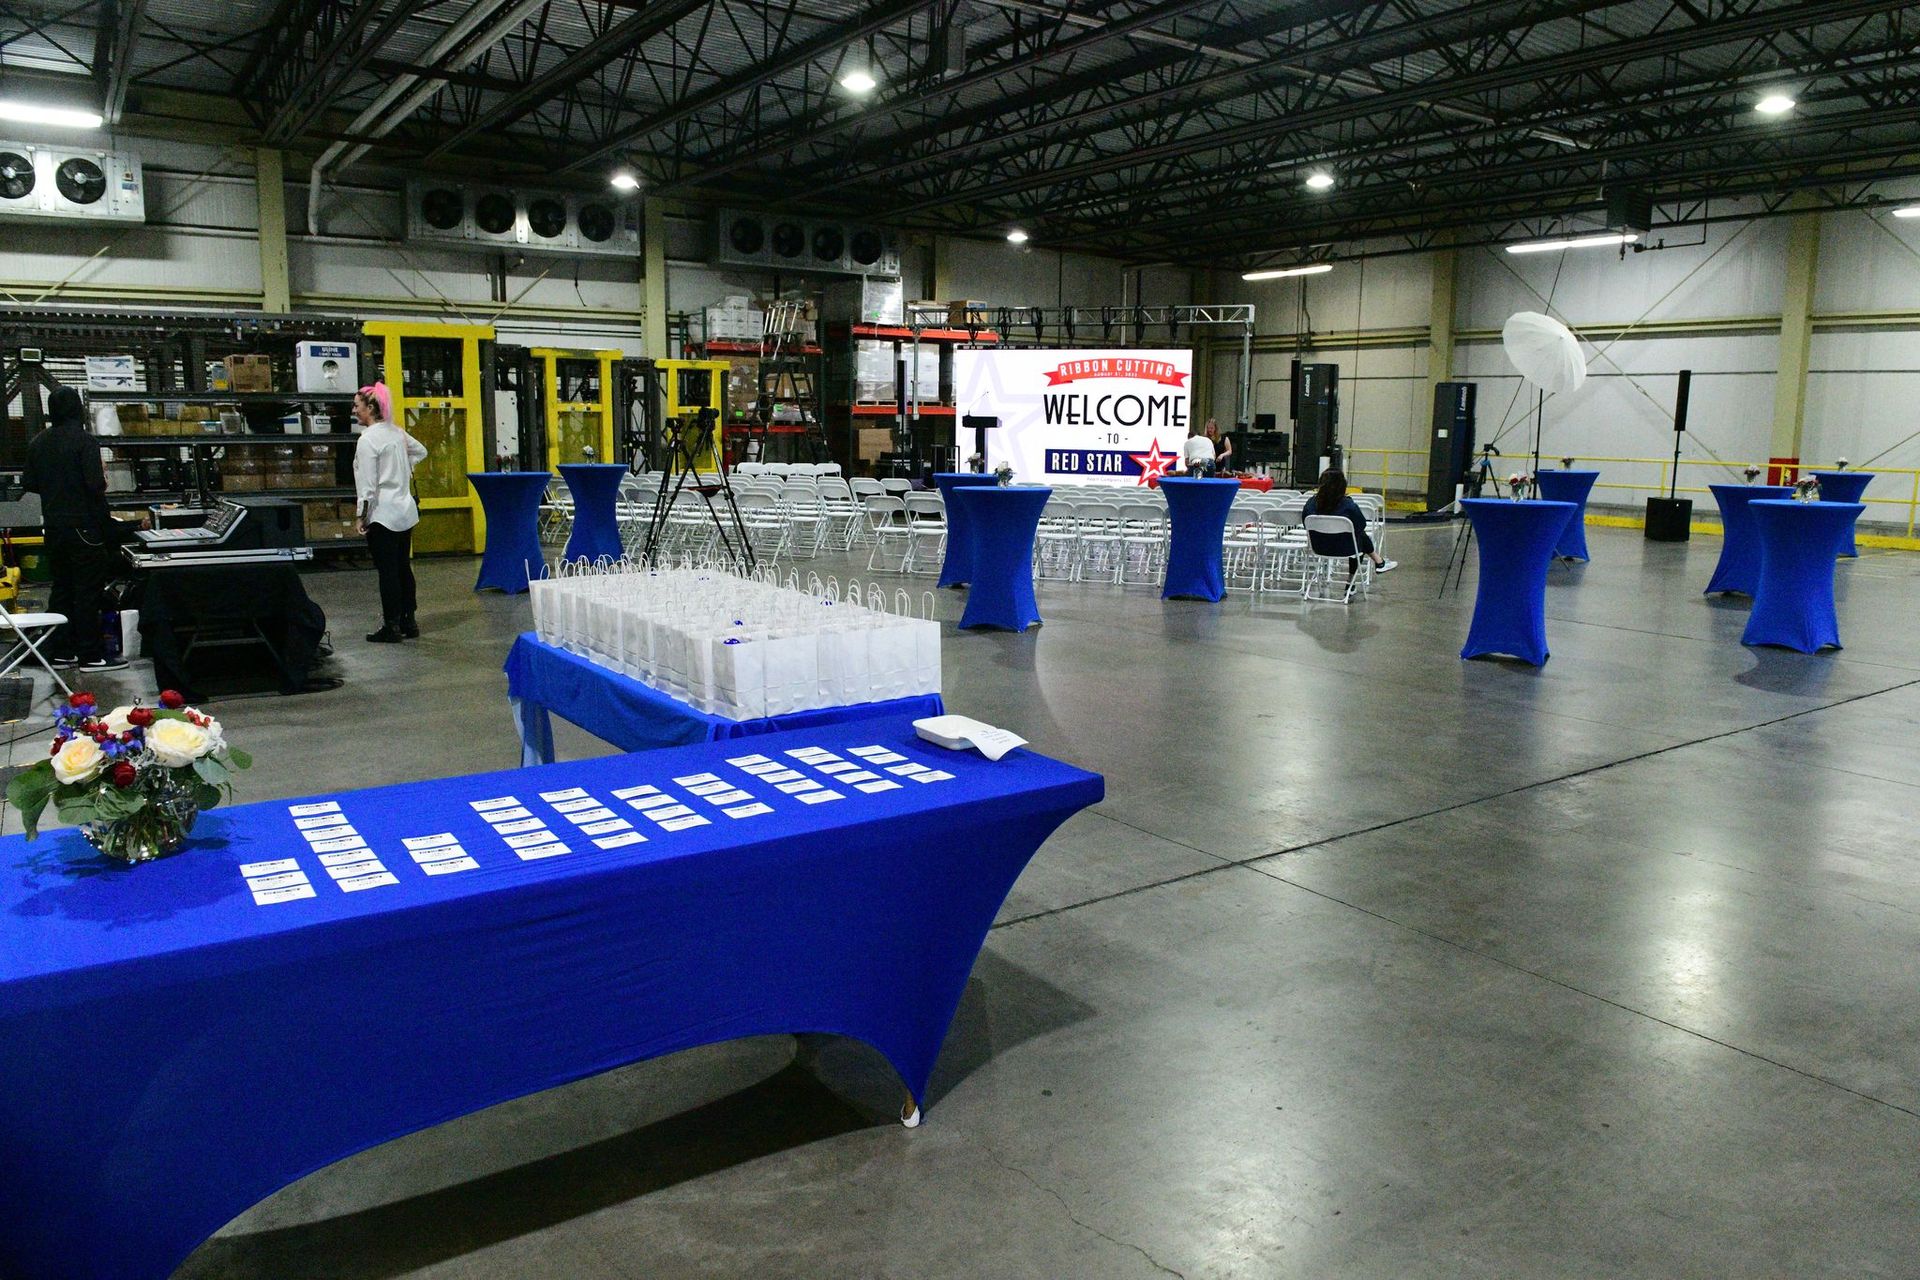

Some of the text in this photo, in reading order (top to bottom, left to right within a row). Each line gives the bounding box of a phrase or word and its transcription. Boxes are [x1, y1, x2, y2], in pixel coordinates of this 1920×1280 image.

[1060, 359, 1175, 377] RIBBON CUTTING
[1043, 394, 1187, 427] WELCOME
[1107, 432, 1119, 445] TO
[1051, 452, 1123, 473] RED STAR
